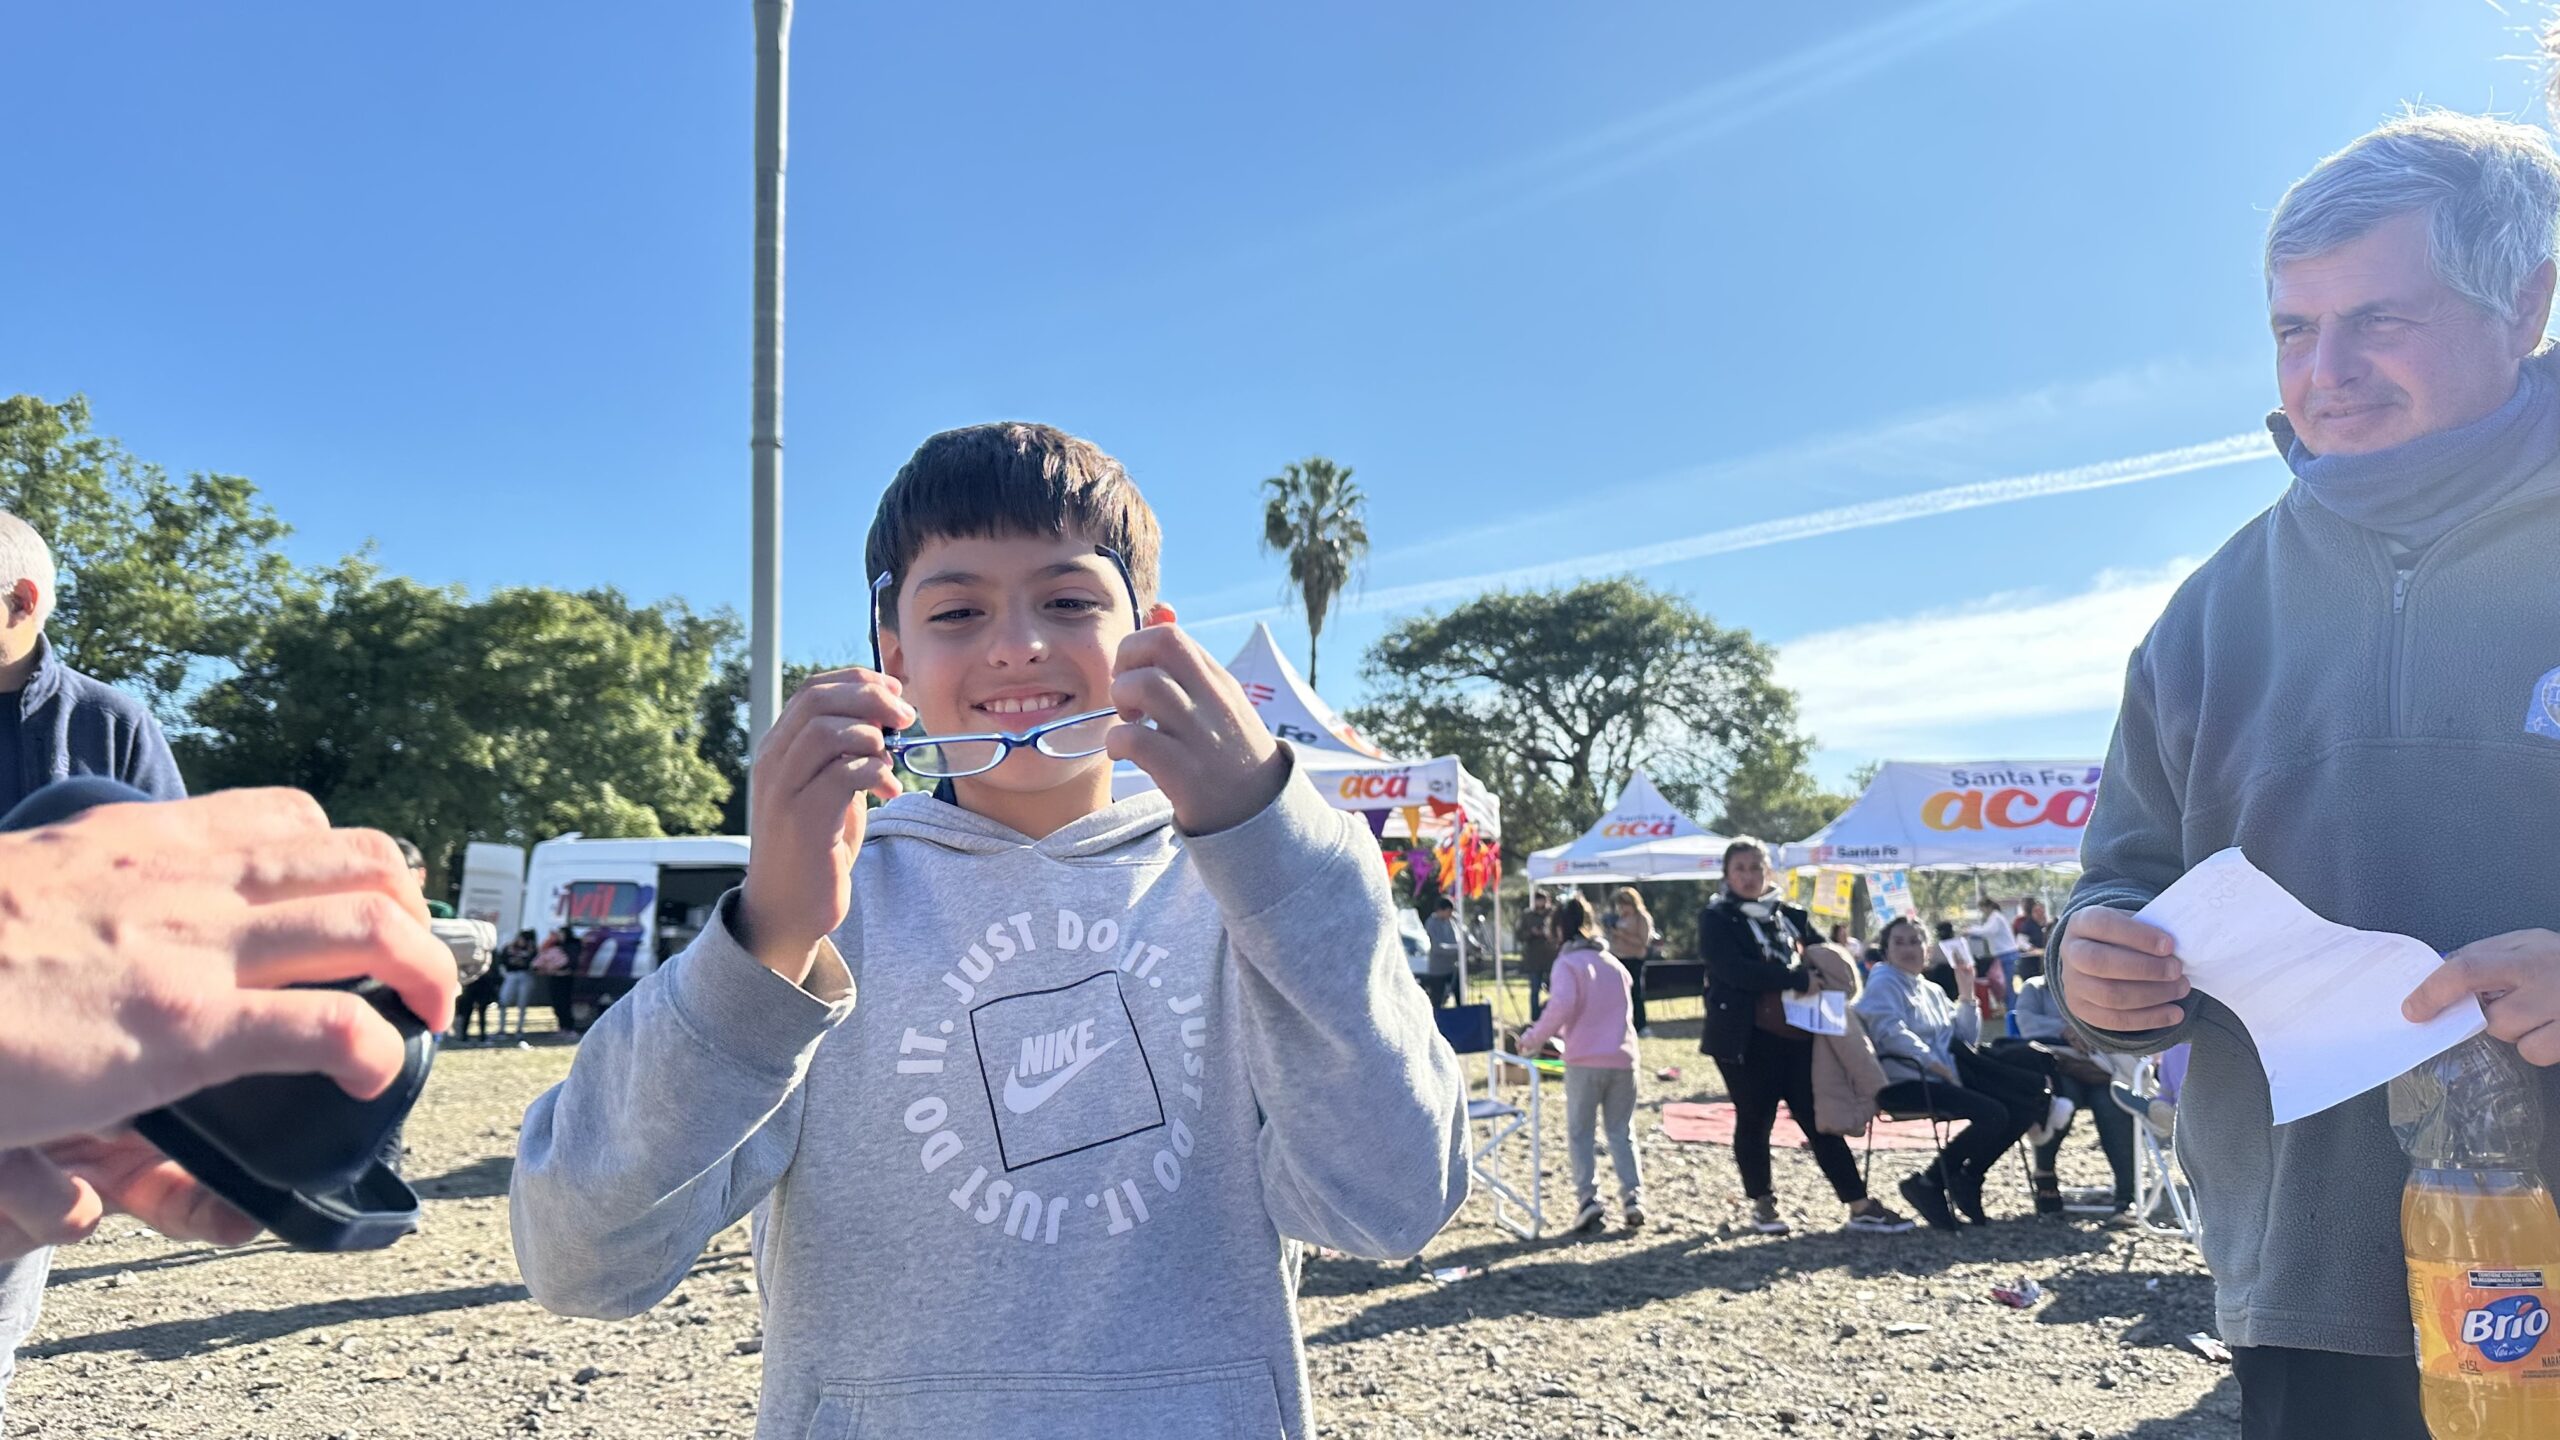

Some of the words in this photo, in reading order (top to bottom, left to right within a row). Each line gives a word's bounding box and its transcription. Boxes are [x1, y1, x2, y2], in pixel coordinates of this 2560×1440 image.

[1952, 769, 2034, 787] Santa
[2039, 770, 2075, 786] Fe
[1836, 846, 1880, 858] Santa
[1882, 845, 1899, 856] Fe
[942, 911, 1036, 1005] JUST
[1057, 909, 1119, 952] DO
[1119, 940, 1169, 988] IT.
[897, 1019, 954, 1073] IT.
[1019, 1018, 1096, 1077] NIKE
[1167, 994, 1206, 1110] JUST
[903, 1097, 964, 1173] DO
[1153, 1118, 1195, 1192] DO
[948, 1165, 1069, 1244] JUST
[1085, 1178, 1150, 1236] IT.
